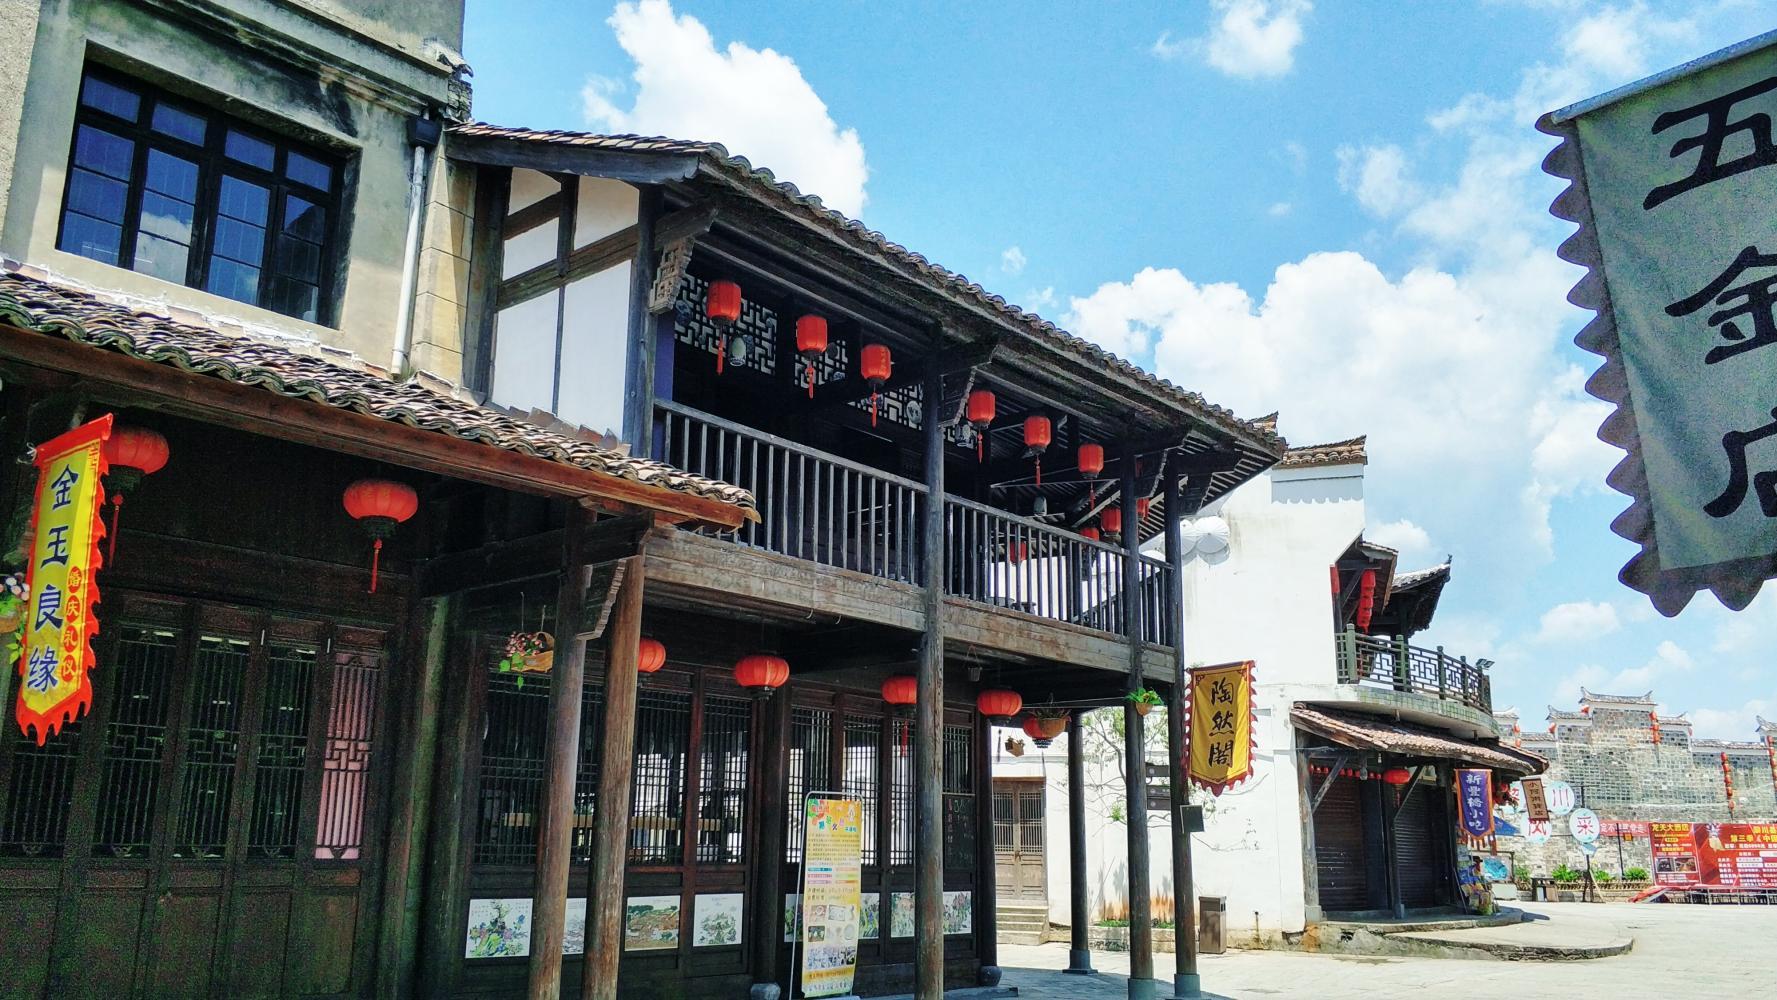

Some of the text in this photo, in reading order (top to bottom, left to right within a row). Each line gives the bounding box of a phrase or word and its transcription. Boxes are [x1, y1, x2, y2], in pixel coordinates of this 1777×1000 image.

[27, 463, 79, 693] 金玉良缘
[62, 569, 82, 680] 婚庆礼仪
